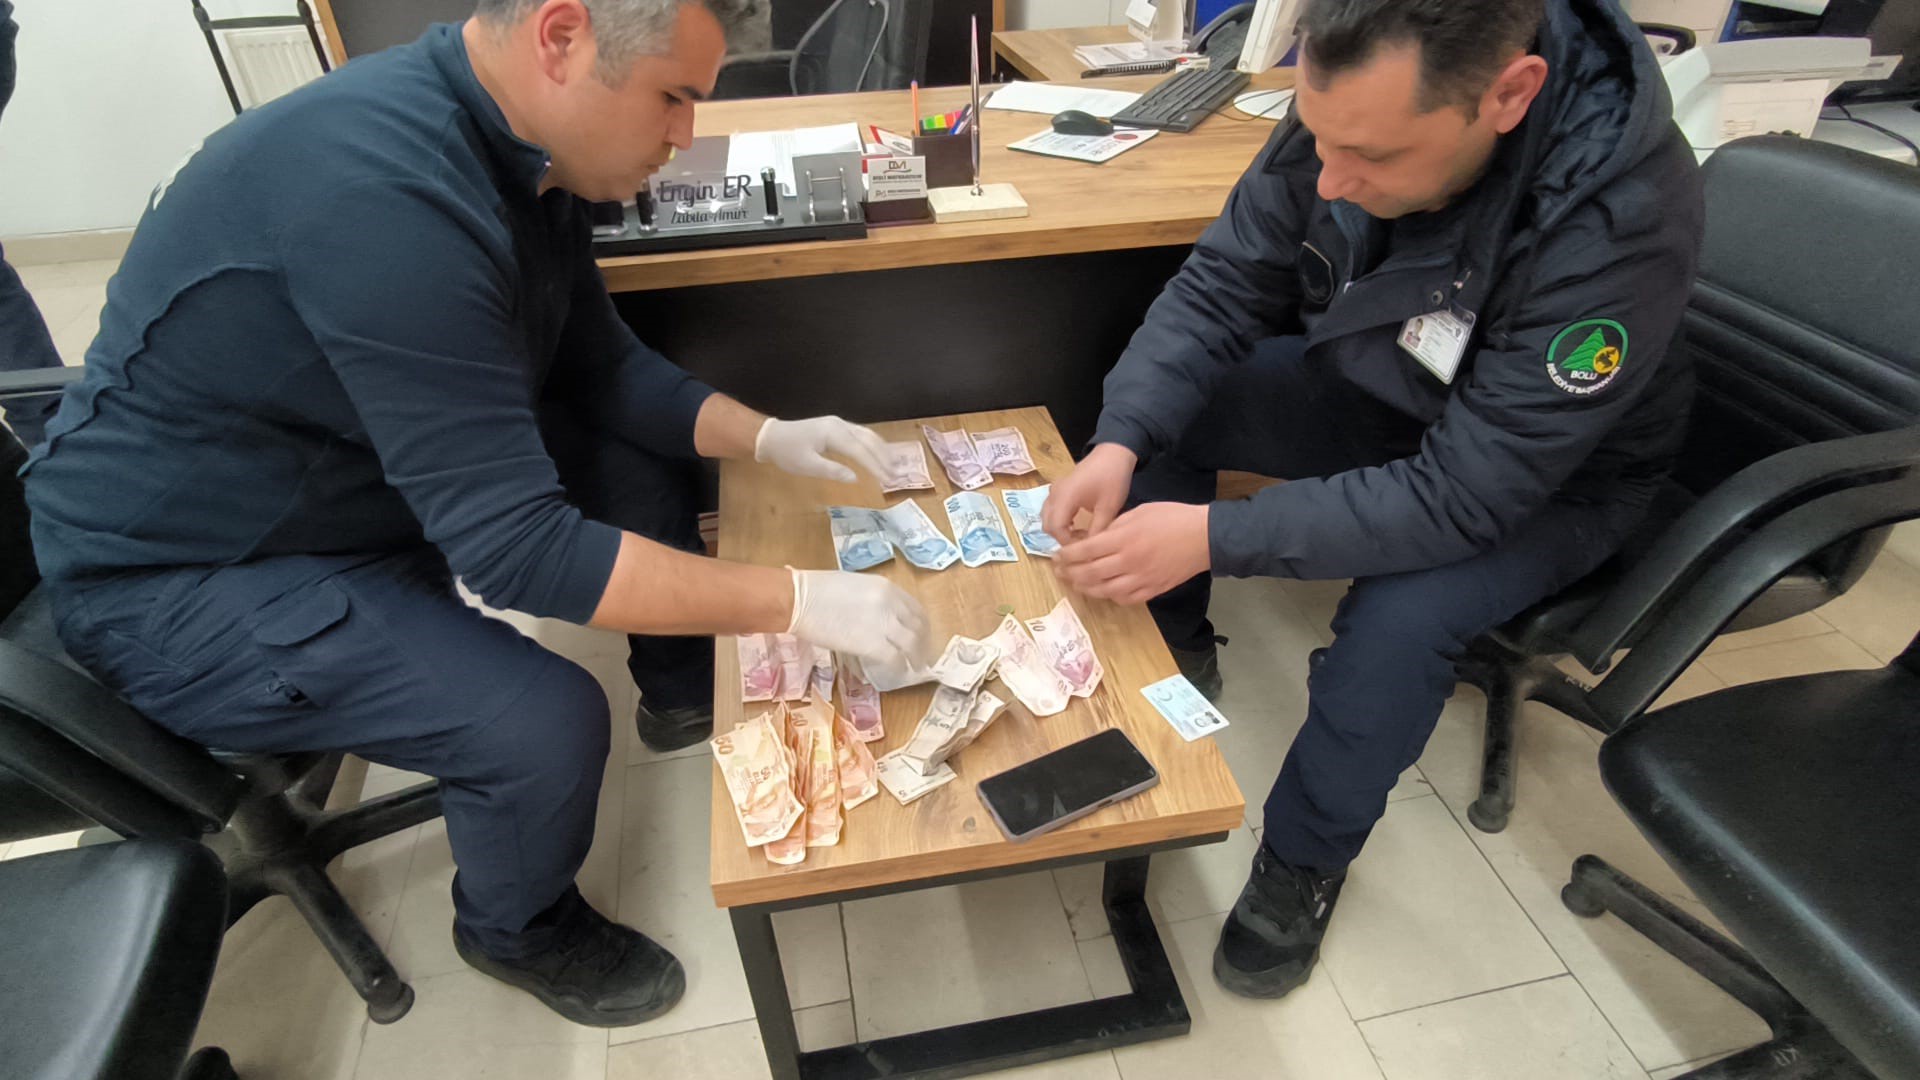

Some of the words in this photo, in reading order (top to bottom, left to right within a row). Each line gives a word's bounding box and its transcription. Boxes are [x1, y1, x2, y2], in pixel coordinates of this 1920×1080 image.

[723, 174, 752, 199] ER
[1570, 369, 1598, 381] BOLU
[1005, 492, 1020, 508] 100
[1004, 619, 1018, 635] 10
[1029, 620, 1047, 632] 10
[714, 735, 735, 755] 50
